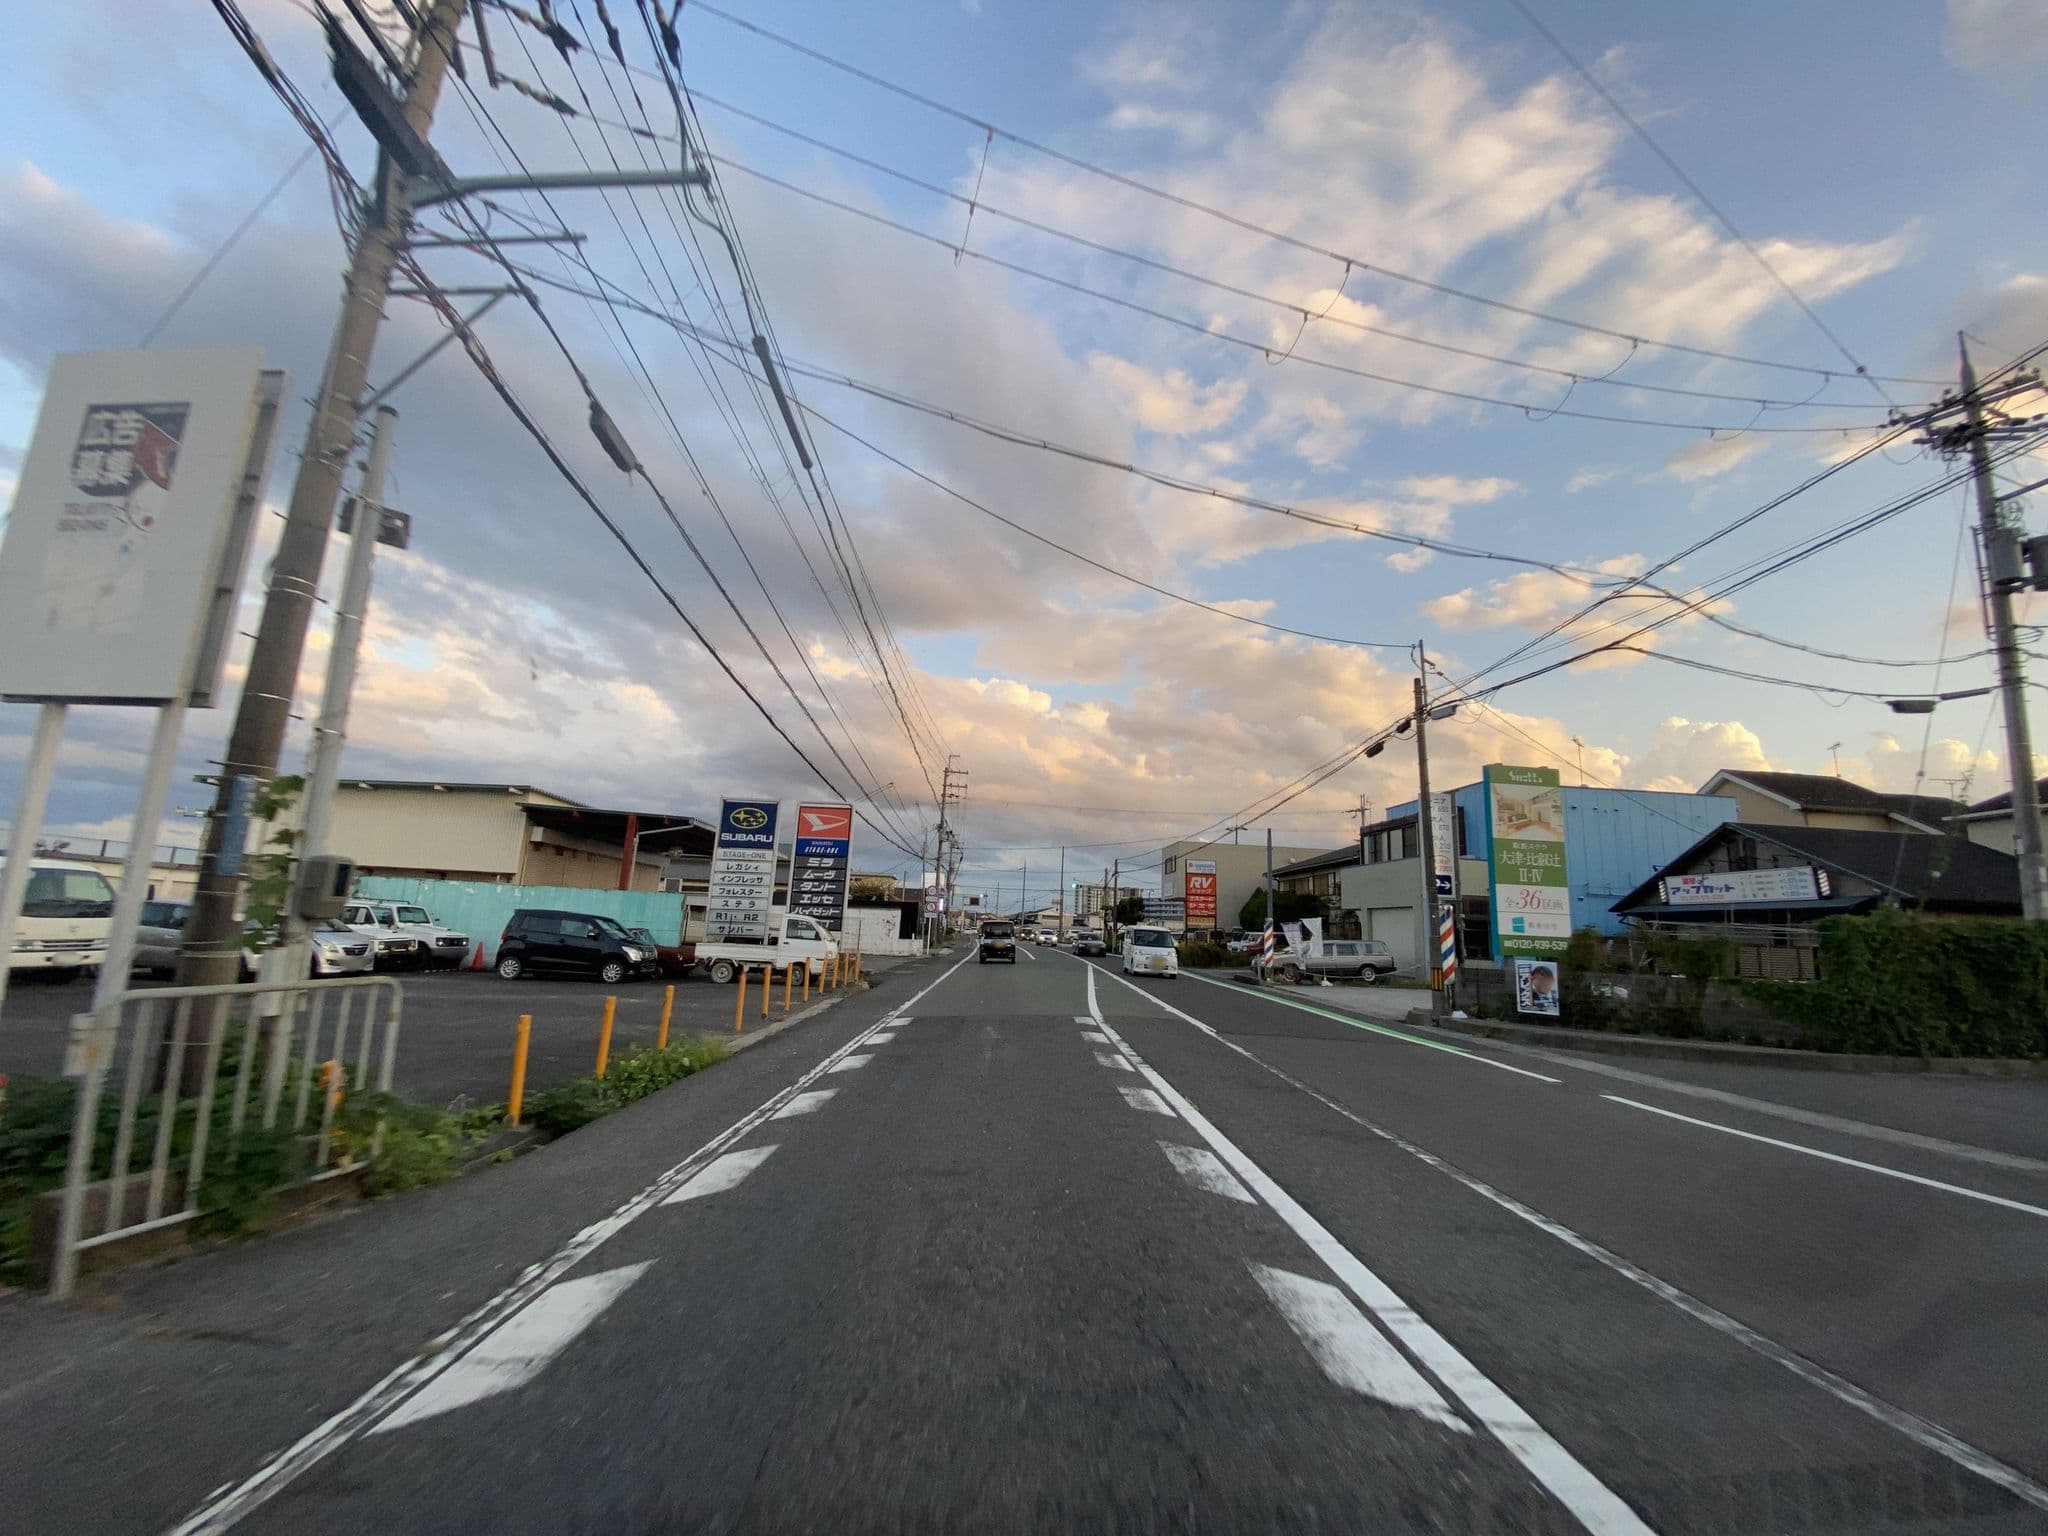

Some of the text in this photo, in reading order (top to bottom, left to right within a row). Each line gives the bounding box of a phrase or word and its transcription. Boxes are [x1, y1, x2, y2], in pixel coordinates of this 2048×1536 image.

[721, 832, 773, 843] SUBARU
[722, 850, 767, 860] STAGE-ONE
[726, 862, 760, 872] レガシィ
[806, 857, 835, 867] ミラ
[719, 875, 763, 884] インプレッサ
[802, 869, 837, 880] ムーヴ
[799, 881, 836, 892] タント
[1189, 876, 1214, 889] RV
[718, 887, 763, 896] フォレスター
[722, 900, 756, 908] ステラ
[799, 894, 834, 904] エッセ
[791, 906, 841, 916] ハイゼット
[718, 925, 754, 934] サンバー
